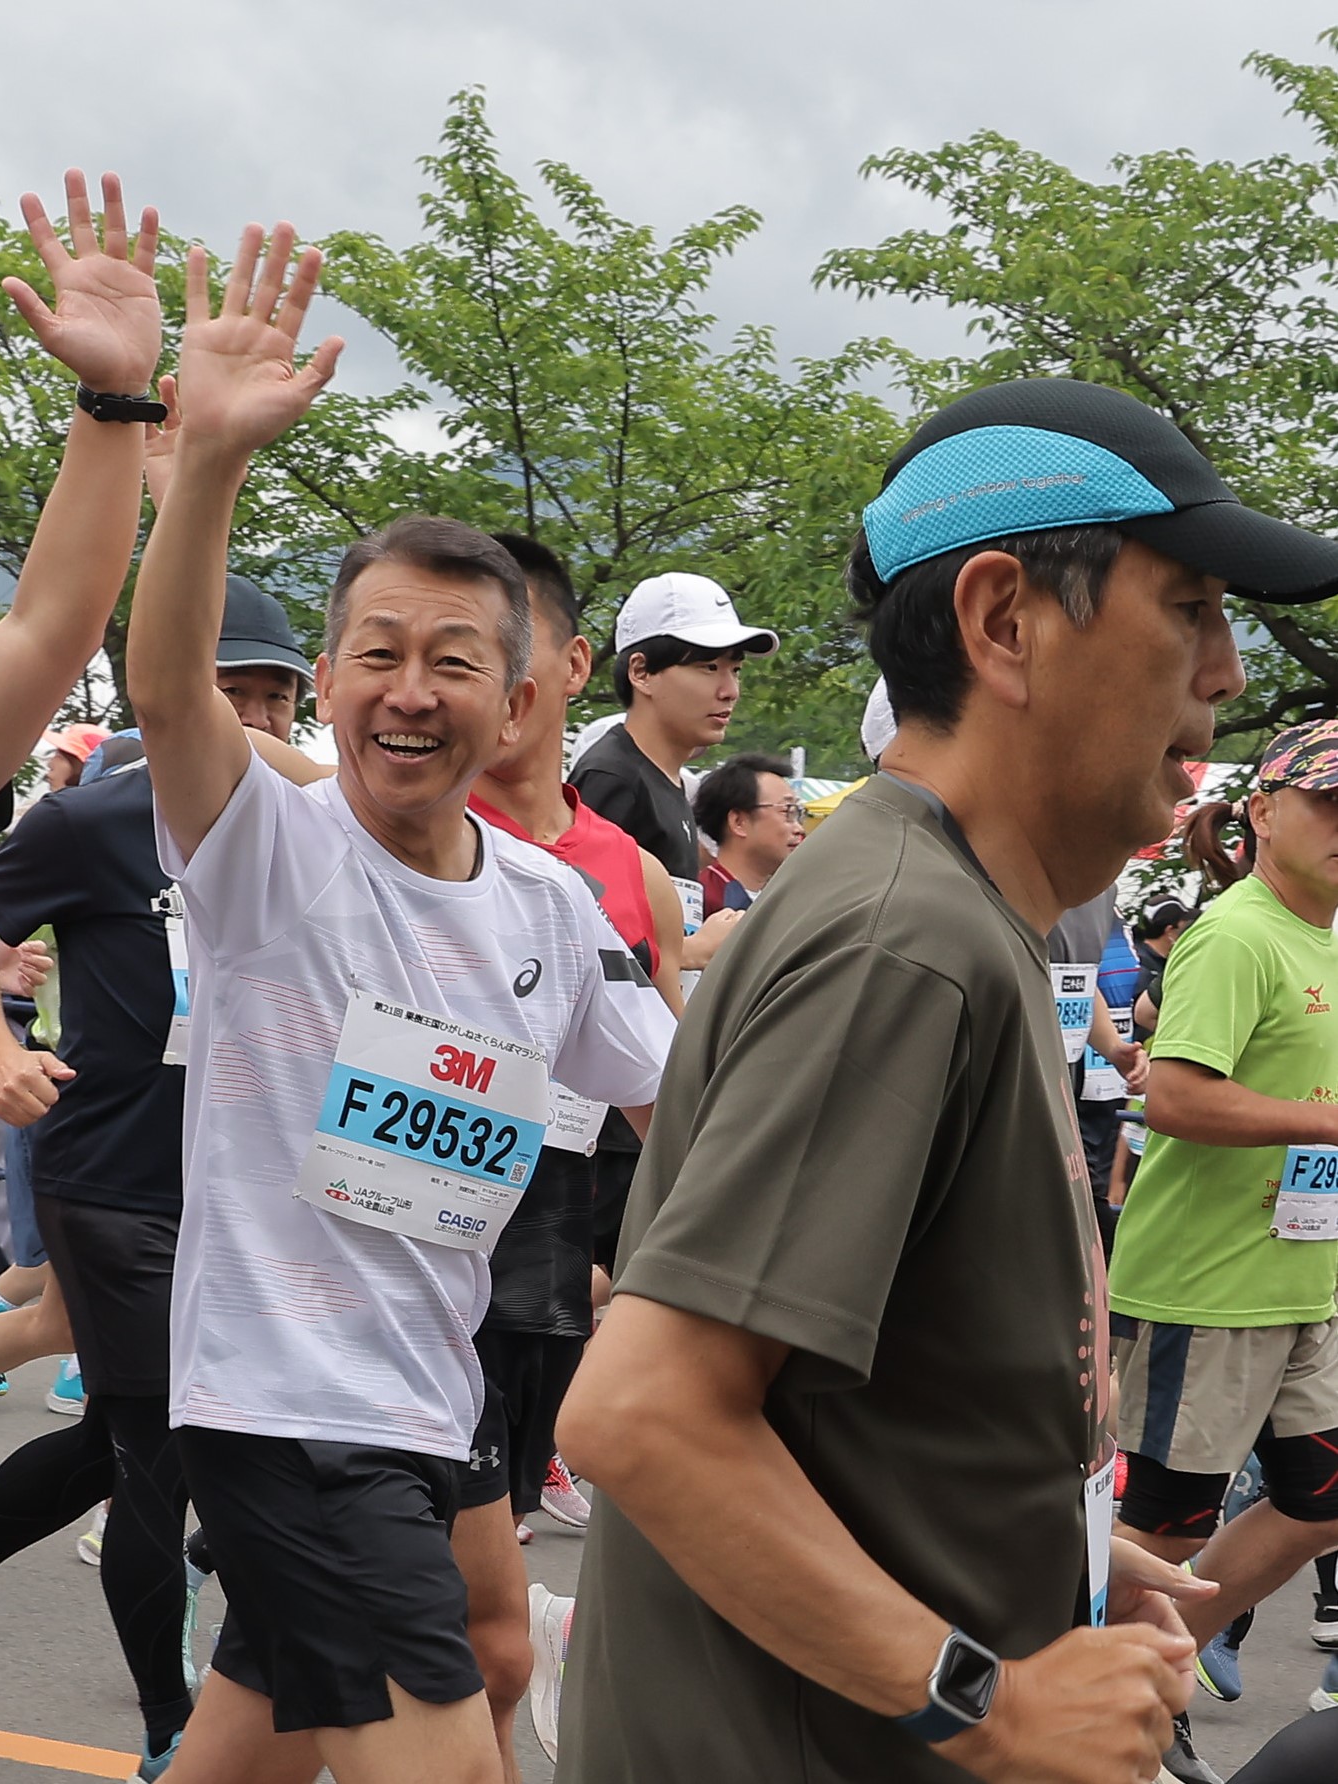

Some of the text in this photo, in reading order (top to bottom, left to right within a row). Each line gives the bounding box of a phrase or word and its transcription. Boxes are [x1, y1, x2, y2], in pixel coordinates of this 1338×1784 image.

[1021, 472, 1087, 490] together
[373, 1001, 404, 1018] 第21回
[429, 1044, 498, 1094] 3M
[437, 1209, 487, 1232] CASIO
